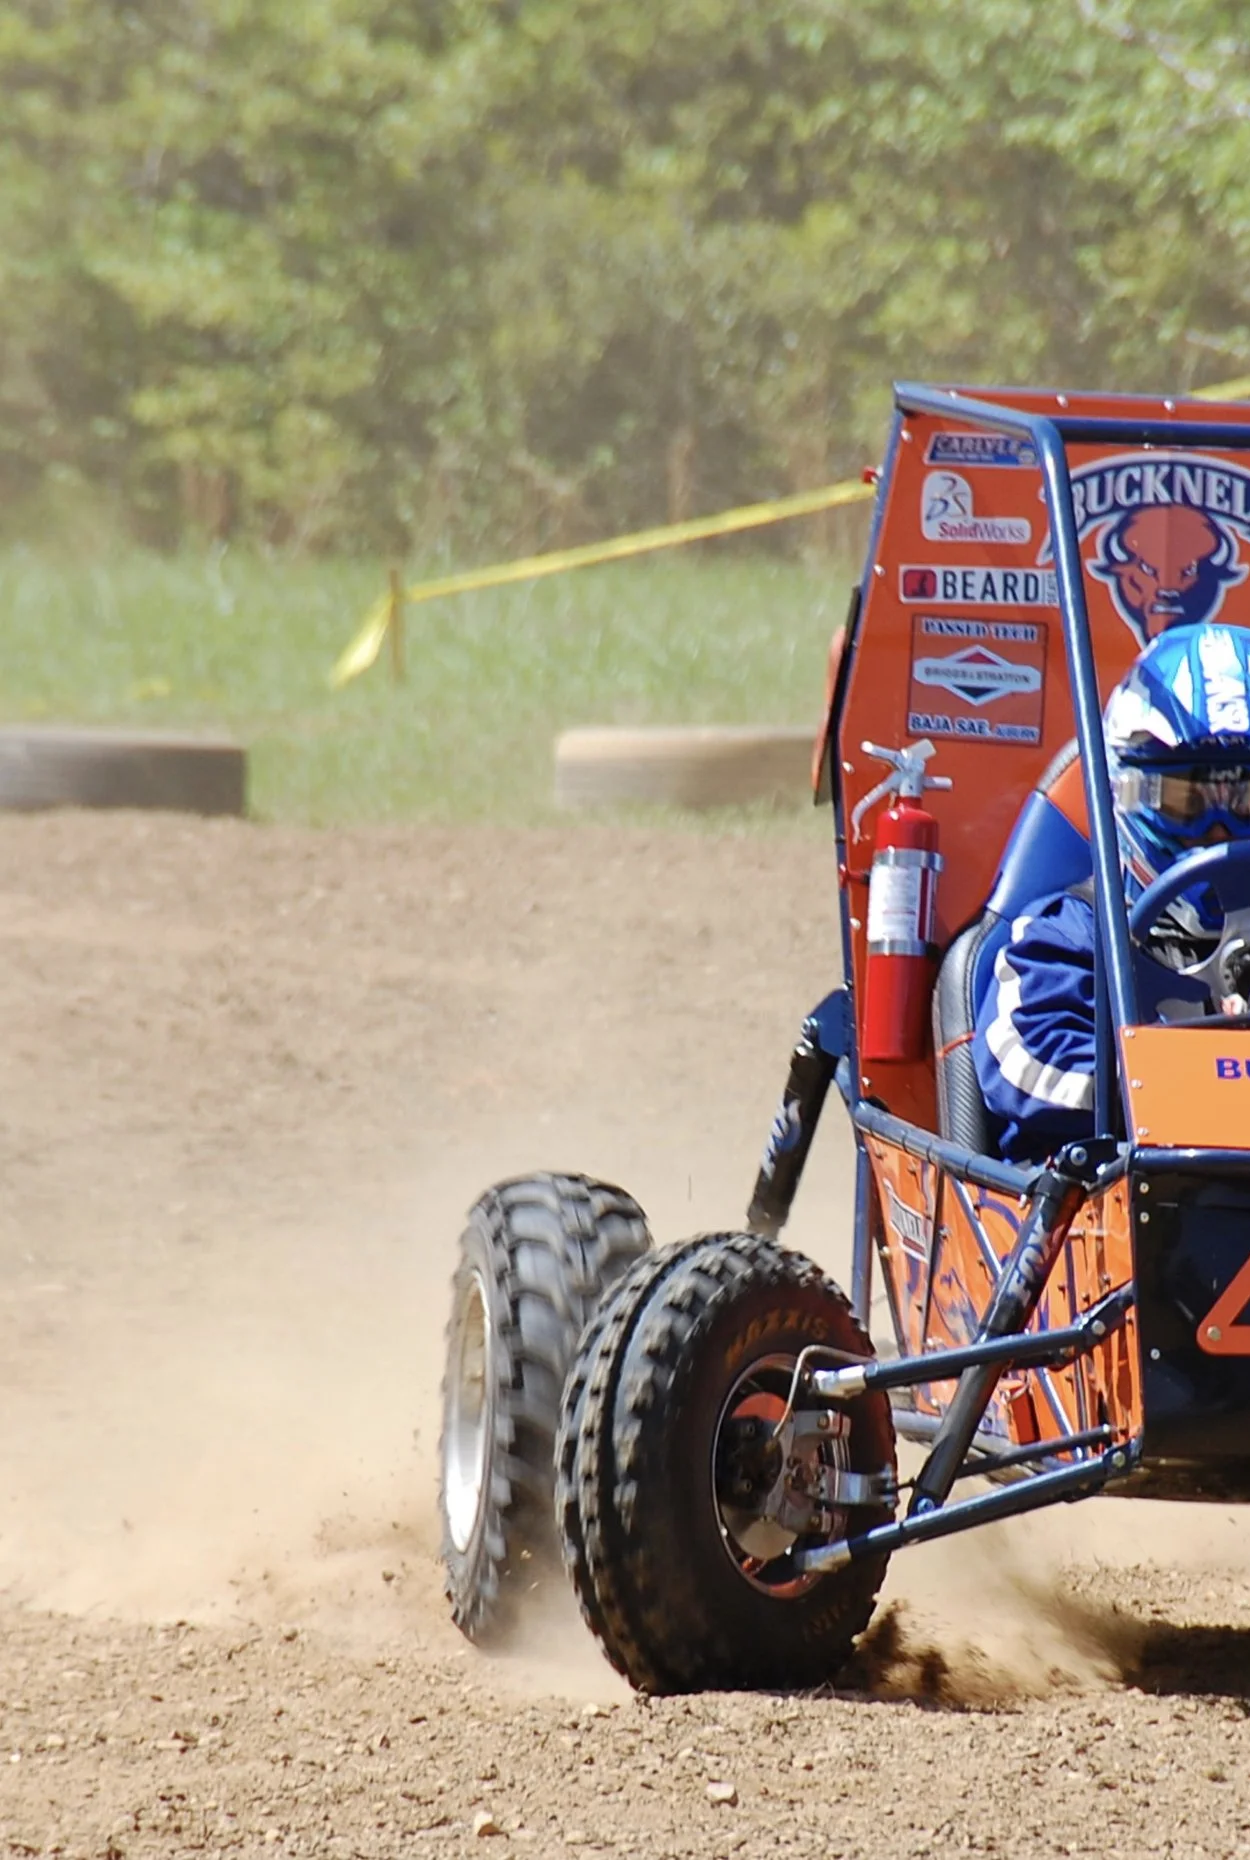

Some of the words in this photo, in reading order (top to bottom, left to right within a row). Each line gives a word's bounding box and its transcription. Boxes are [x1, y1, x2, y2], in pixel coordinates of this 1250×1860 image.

[941, 569, 1040, 603] BEARD
[923, 618, 987, 638] PASSED
[993, 624, 1037, 642] TECH
[910, 713, 951, 732] BAJA
[957, 717, 988, 737] SAE
